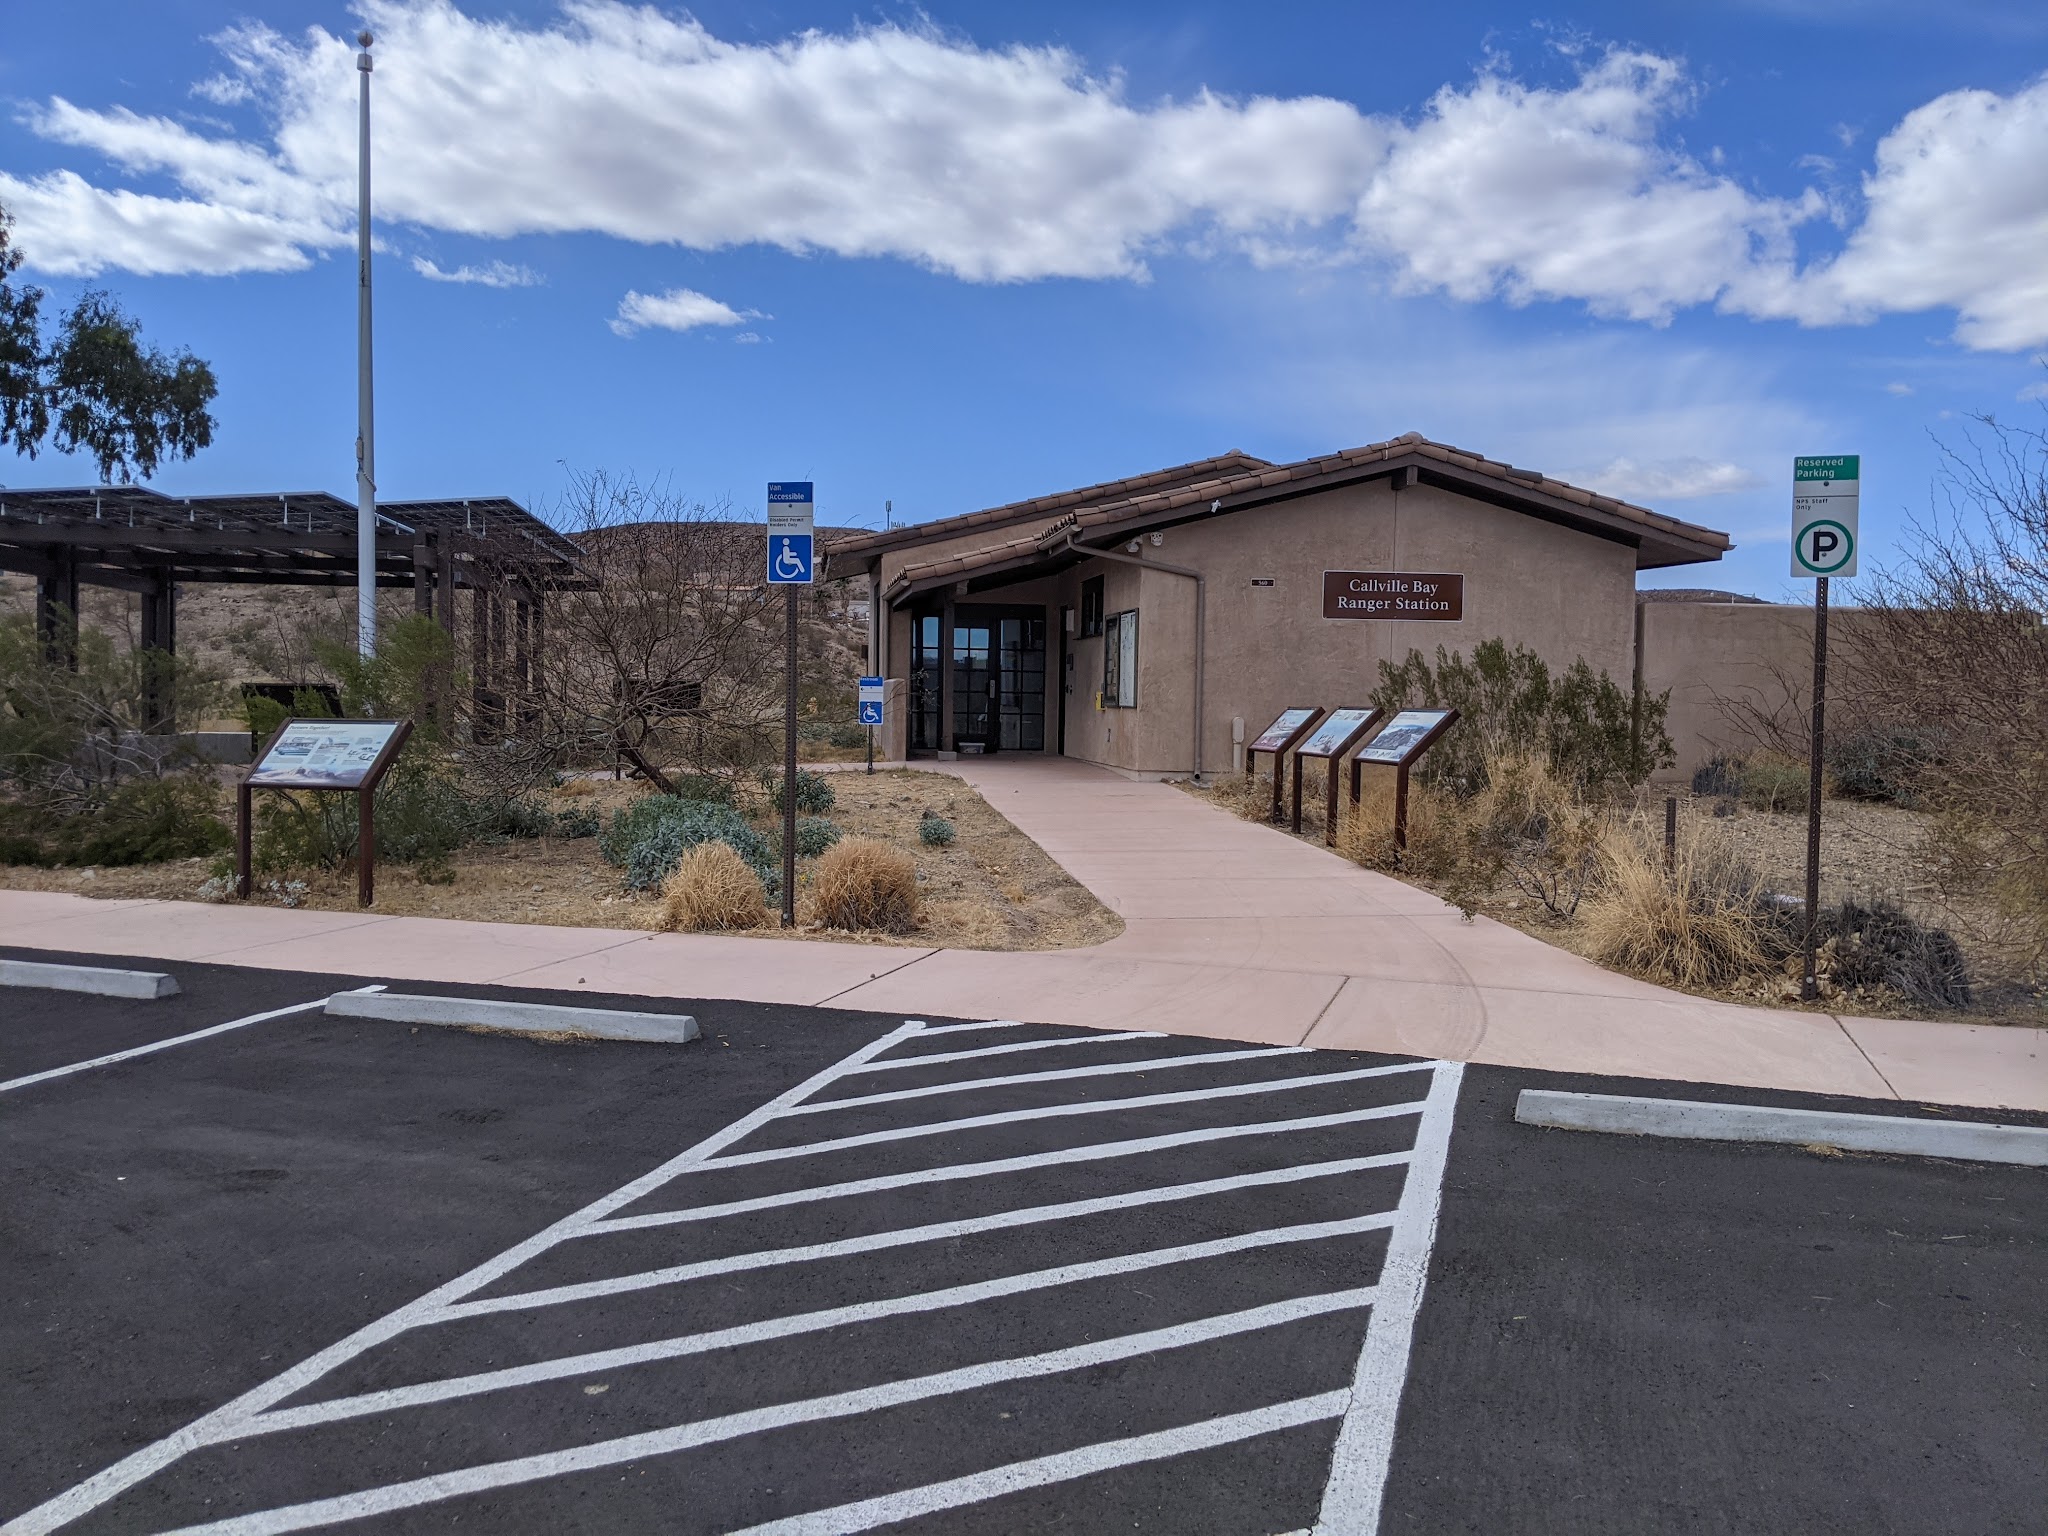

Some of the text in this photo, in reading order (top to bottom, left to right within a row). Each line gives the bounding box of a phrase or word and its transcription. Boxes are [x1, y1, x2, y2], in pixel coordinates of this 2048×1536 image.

[1797, 458, 1844, 467] Reserved
[1796, 469, 1835, 479] Parking
[1812, 531, 1839, 562] P
[1349, 579, 1439, 596] Callville Bay
[1337, 596, 1449, 612] Ranger Station
